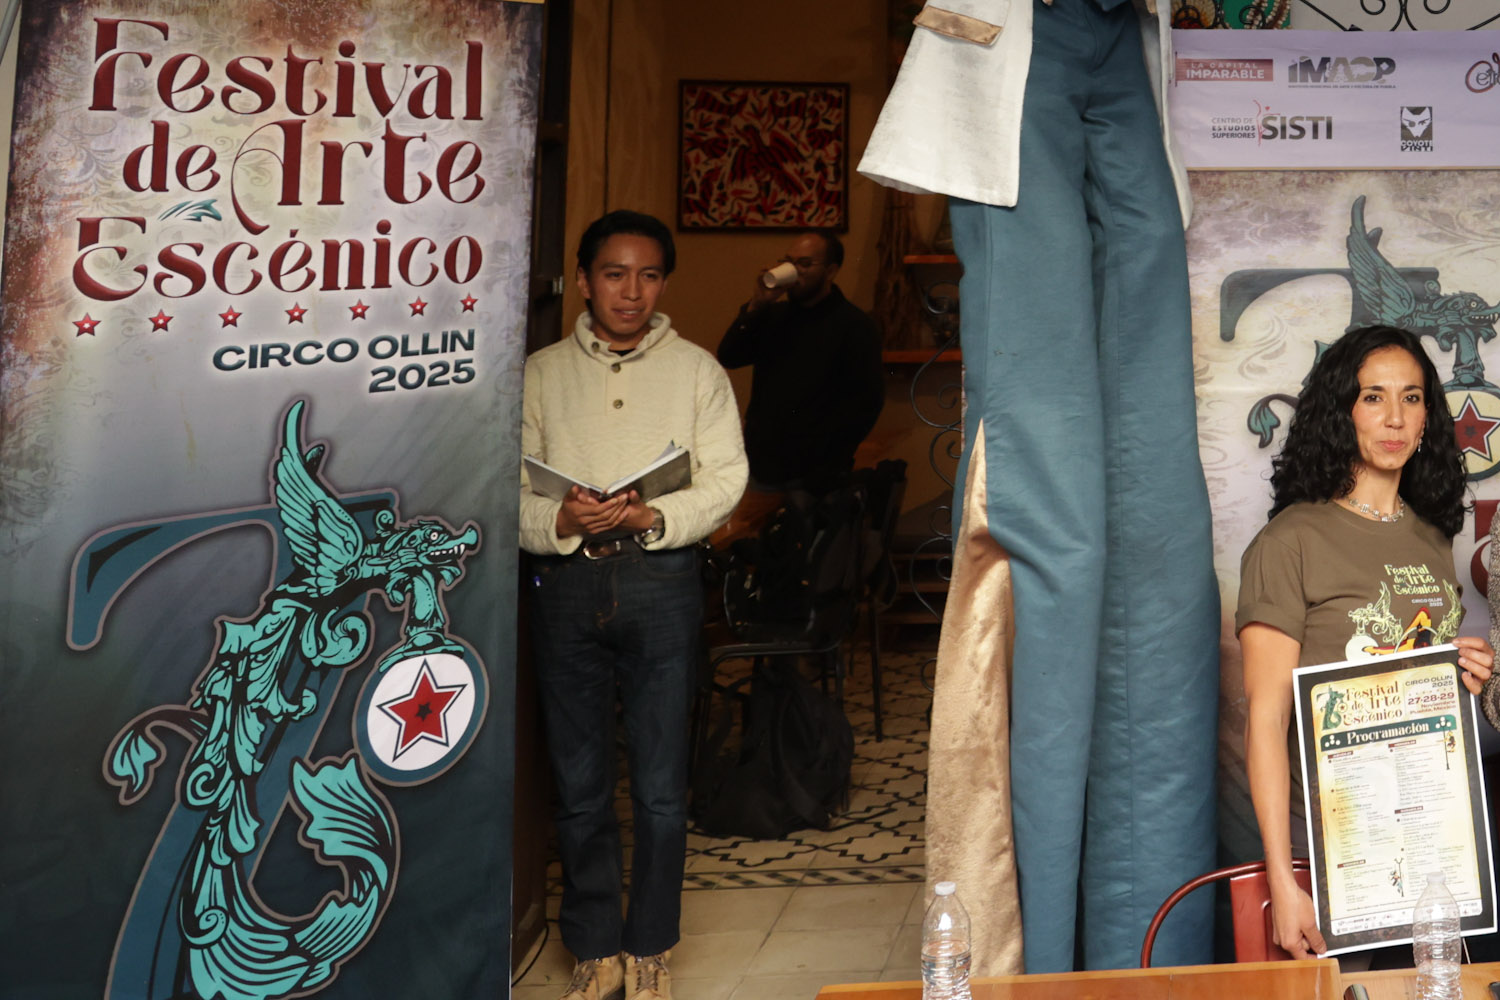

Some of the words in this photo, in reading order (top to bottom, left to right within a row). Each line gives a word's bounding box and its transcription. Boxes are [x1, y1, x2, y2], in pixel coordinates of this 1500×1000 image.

[88, 17, 483, 120] Festival
[1186, 68, 1265, 79] IMPARABLE
[1211, 117, 1240, 125] CENTRO
[1261, 116, 1333, 140] SISTI
[123, 120, 221, 192] de
[231, 119, 485, 235] Arte
[72, 217, 483, 301] Escénico
[212, 337, 361, 372] CIRCO
[367, 328, 476, 359] OLLIN
[368, 358, 477, 394] 2025
[1384, 563, 1430, 576] Festival
[1345, 680, 1399, 701] Festival
[1405, 678, 1430, 686] CIRCO
[1430, 674, 1453, 682] OLLIN
[1432, 680, 1454, 688] 2025
[1351, 700, 1363, 711] de
[1346, 721, 1430, 745] Programación
